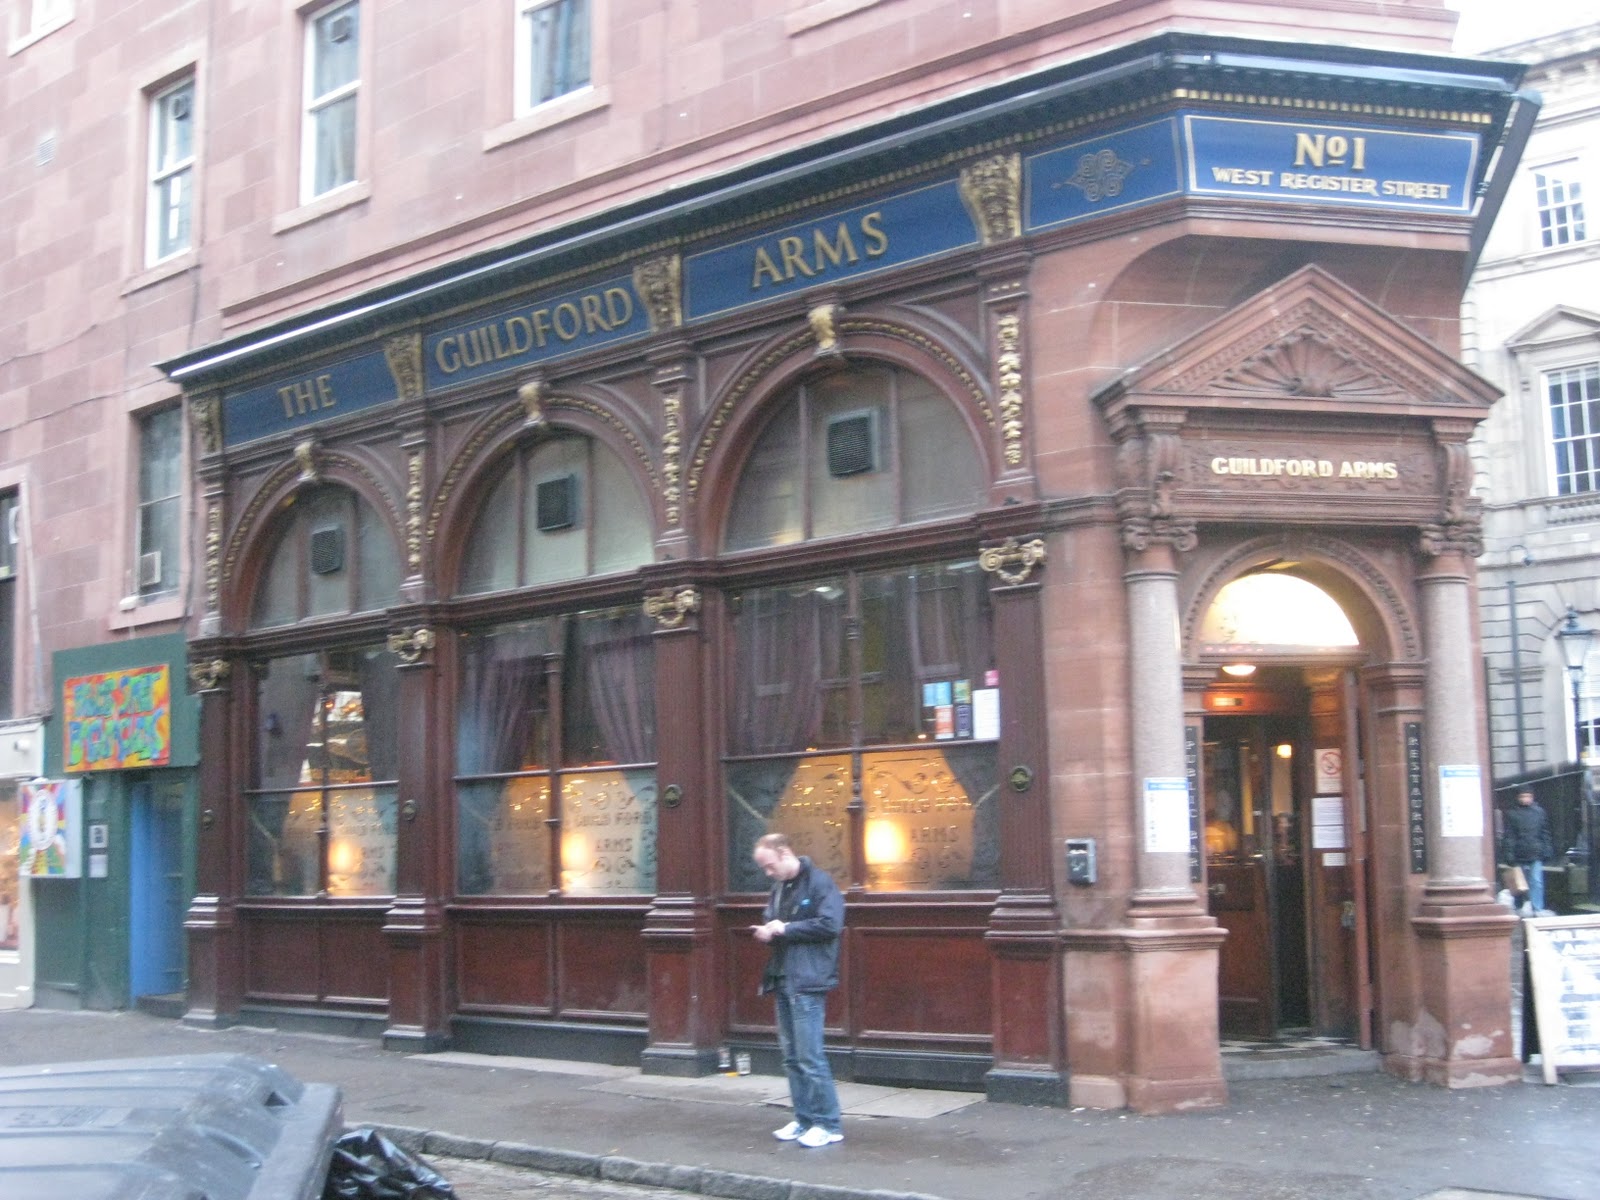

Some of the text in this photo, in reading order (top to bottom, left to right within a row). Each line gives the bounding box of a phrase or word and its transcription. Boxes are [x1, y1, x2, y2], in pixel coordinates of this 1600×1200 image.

[1212, 167, 1451, 200] WEST REGISTER STREET
[277, 211, 889, 419] THE GUILDFORD ARMS
[1211, 457, 1399, 479] GUILDFORD ARMS
[1408, 736, 1425, 859] RESTAURANT
